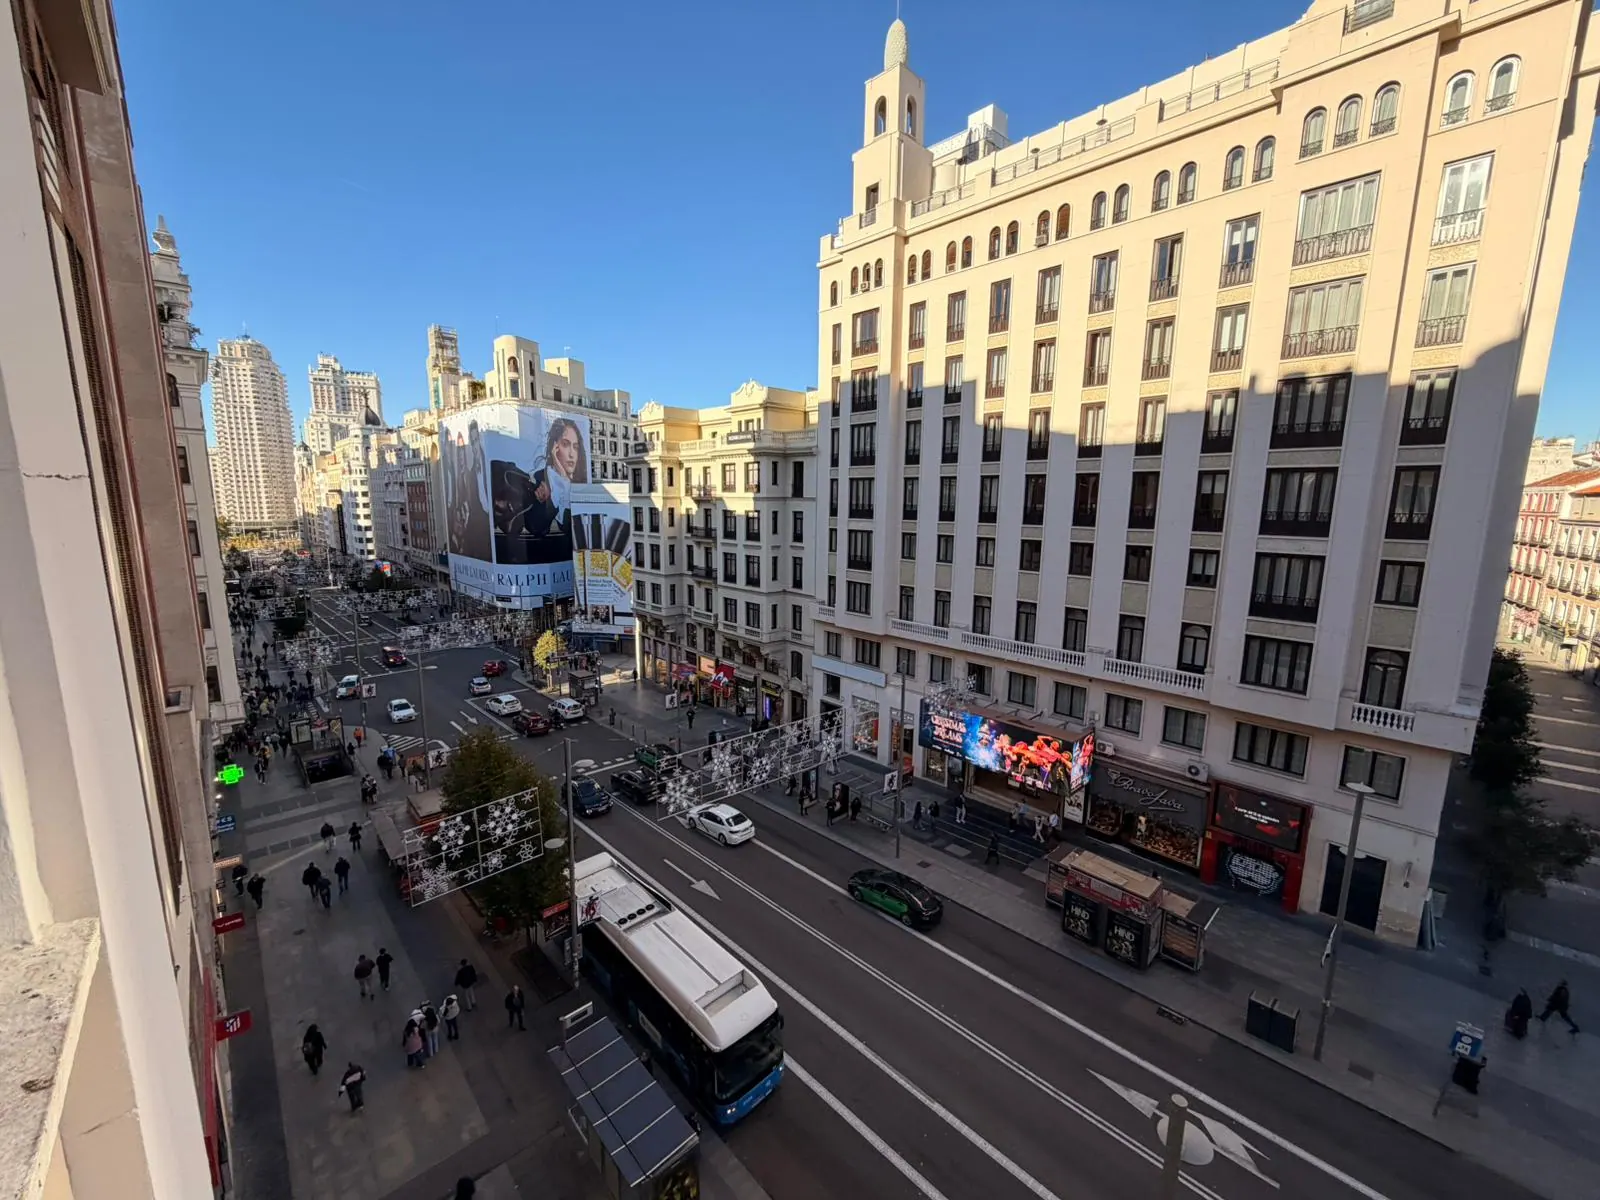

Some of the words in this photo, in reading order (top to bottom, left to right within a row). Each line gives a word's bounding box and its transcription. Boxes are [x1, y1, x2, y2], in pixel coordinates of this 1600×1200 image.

[470, 567, 489, 582] LAUREN
[497, 573, 546, 586] RALPH
[931, 715, 967, 733] CHRISTMAS
[1113, 776, 1155, 797] Bravo
[1139, 789, 1184, 810] Java
